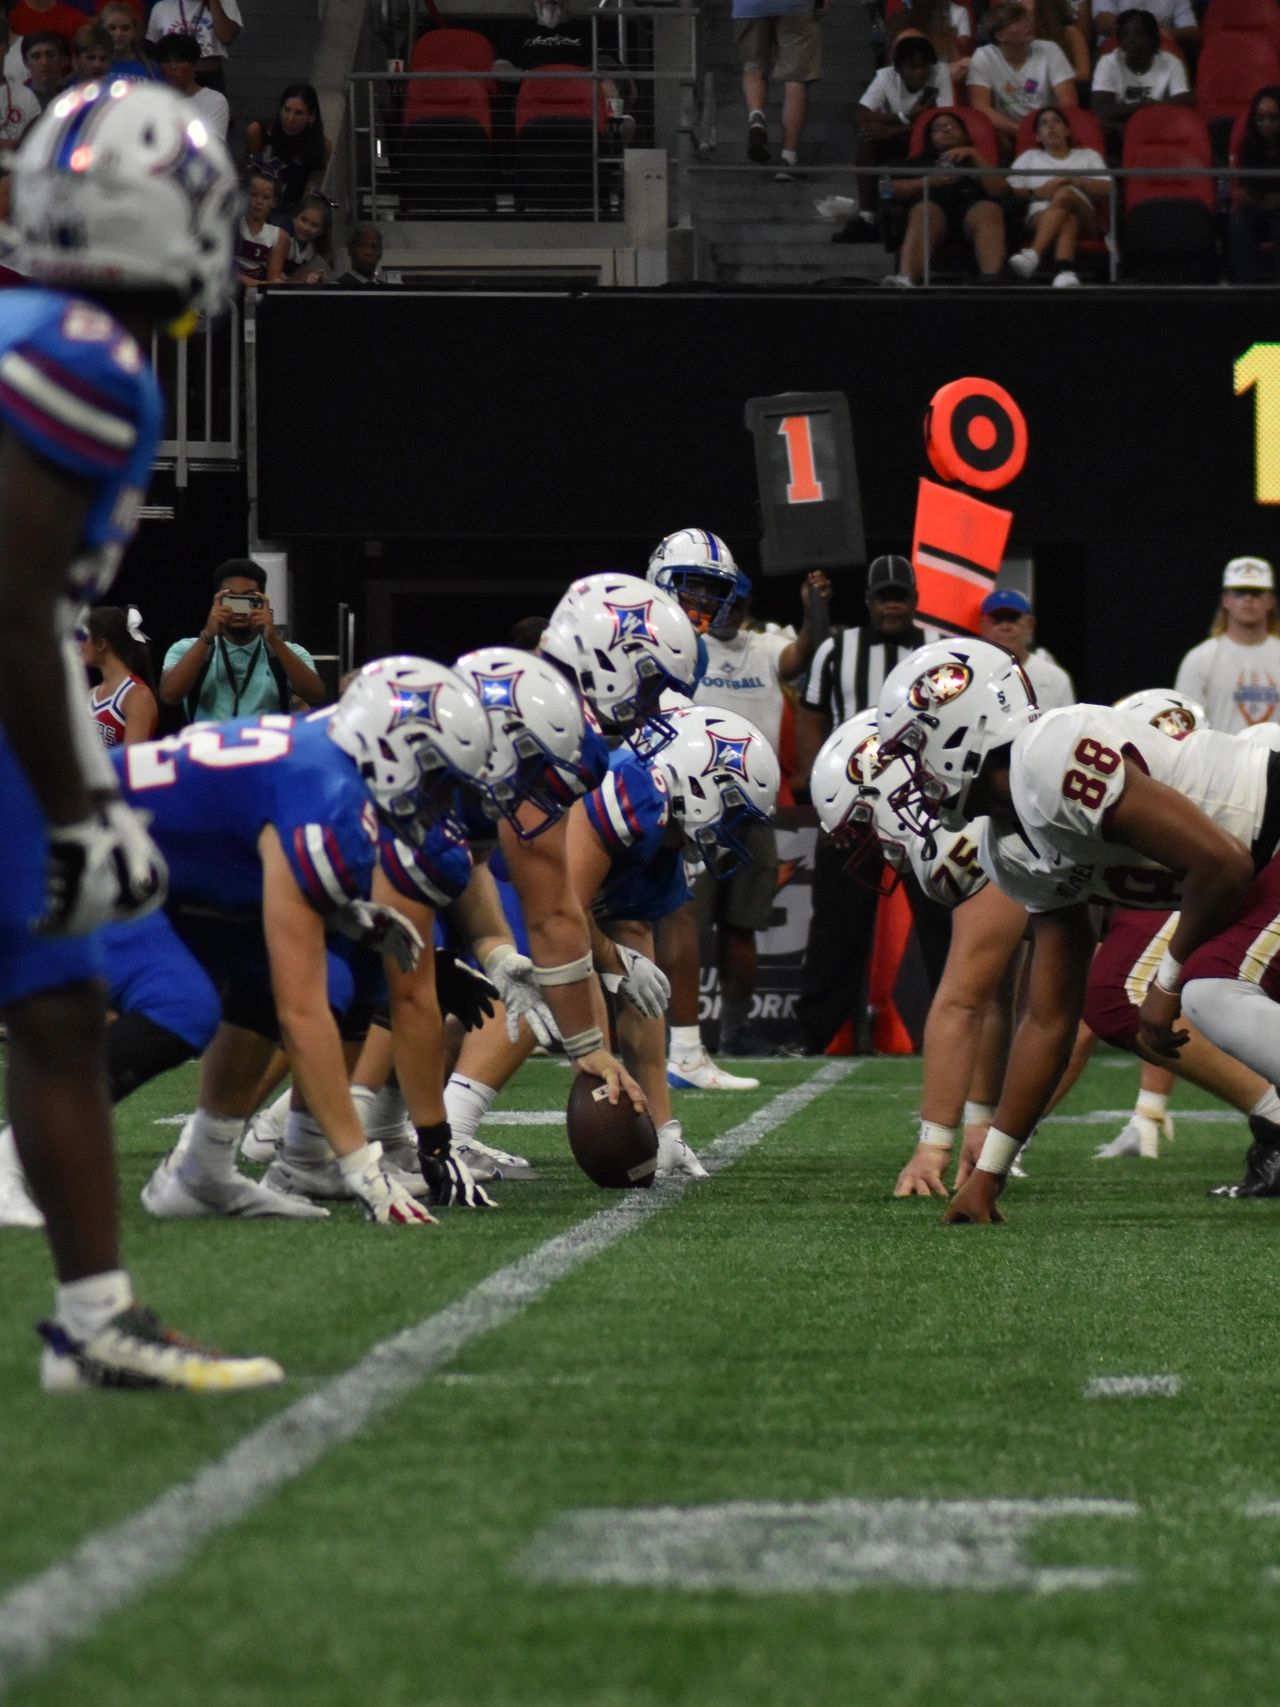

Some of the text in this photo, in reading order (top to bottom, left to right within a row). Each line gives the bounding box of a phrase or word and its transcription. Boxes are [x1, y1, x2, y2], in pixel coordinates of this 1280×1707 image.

[777, 415, 823, 504] 1
[698, 676, 765, 690] OOTBALL
[1062, 737, 1122, 811] 88
